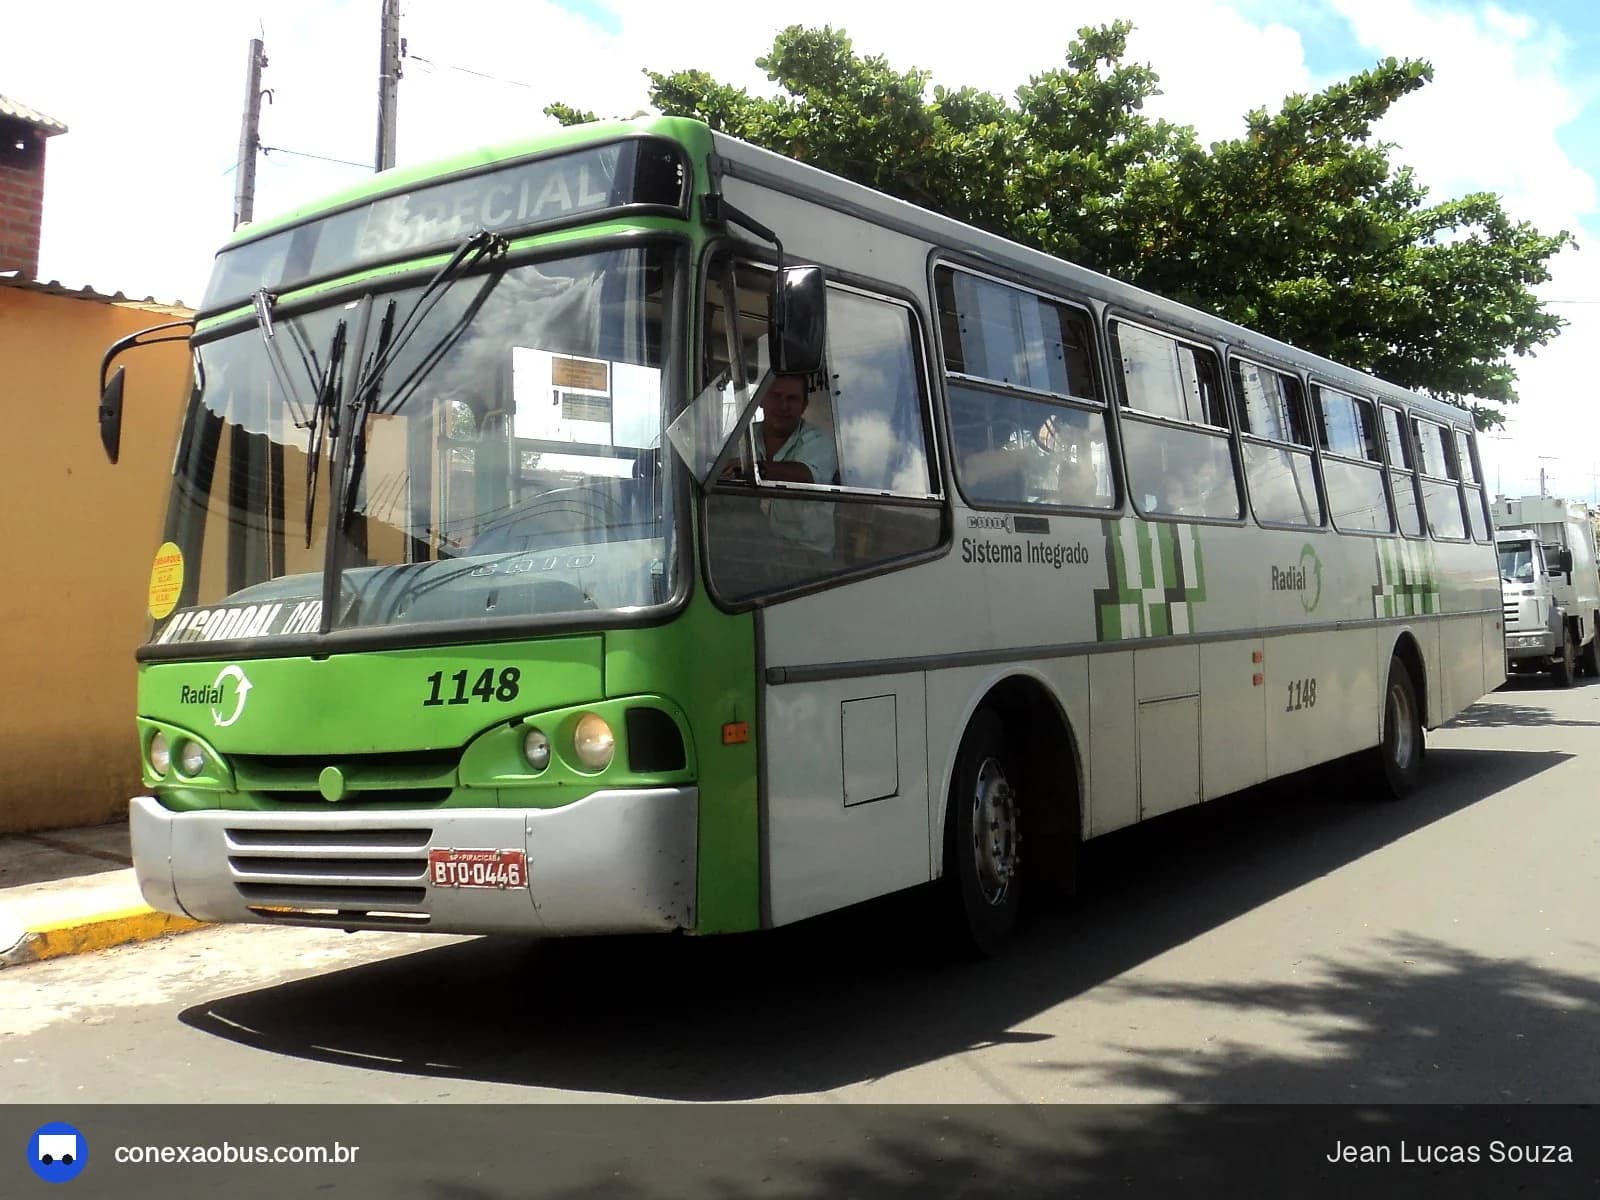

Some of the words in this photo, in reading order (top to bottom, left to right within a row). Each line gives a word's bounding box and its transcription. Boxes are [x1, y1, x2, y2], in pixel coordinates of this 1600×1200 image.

[470, 553, 596, 578] CAIO
[961, 537, 1022, 564] Sistema
[1027, 541, 1089, 569] Integrado
[1271, 565, 1306, 591] Radial
[157, 603, 284, 645] ALGODOAL
[181, 685, 224, 704] Radial
[423, 667, 521, 706] 1148
[1286, 678, 1317, 712] 1148
